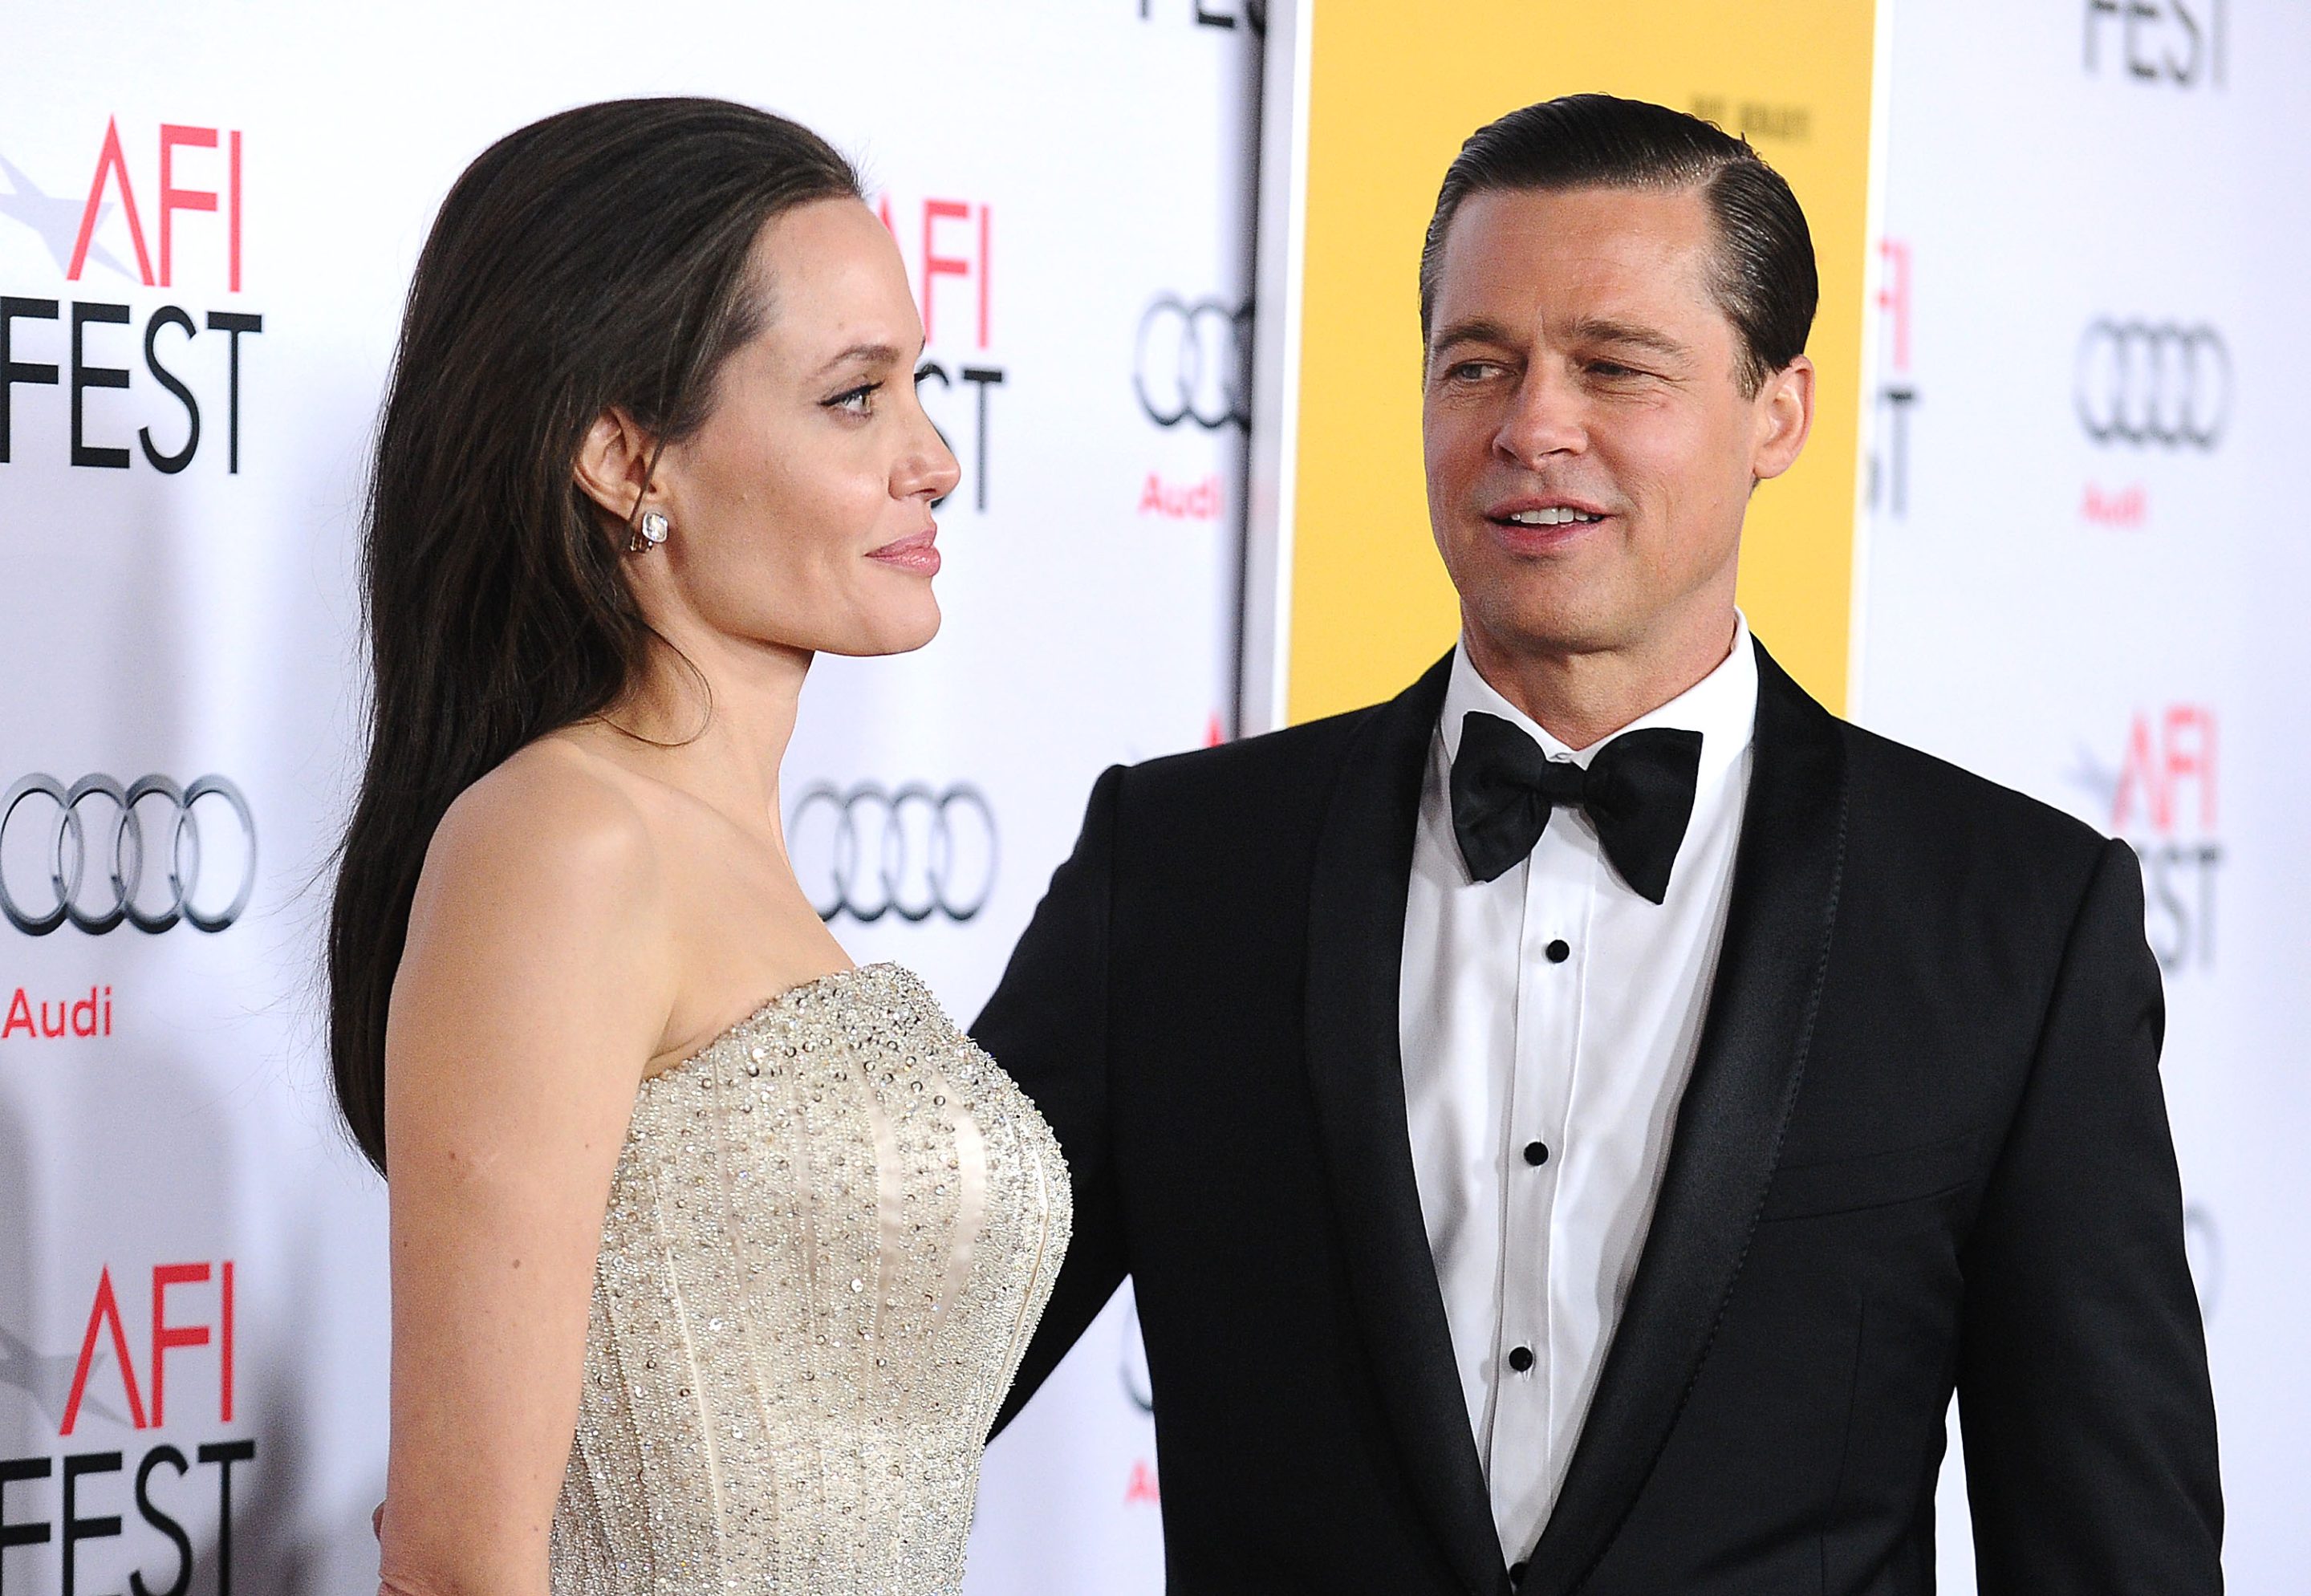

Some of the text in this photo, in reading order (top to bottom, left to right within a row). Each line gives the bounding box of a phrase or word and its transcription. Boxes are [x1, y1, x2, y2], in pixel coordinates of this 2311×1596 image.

[66, 113, 242, 293] AFI
[878, 194, 990, 350] FI
[0, 295, 263, 475] FEST
[2109, 708, 2220, 831] AFI
[1, 986, 112, 1038] Audi
[59, 1261, 234, 1436] AFI
[0, 1440, 255, 1596] FEST
